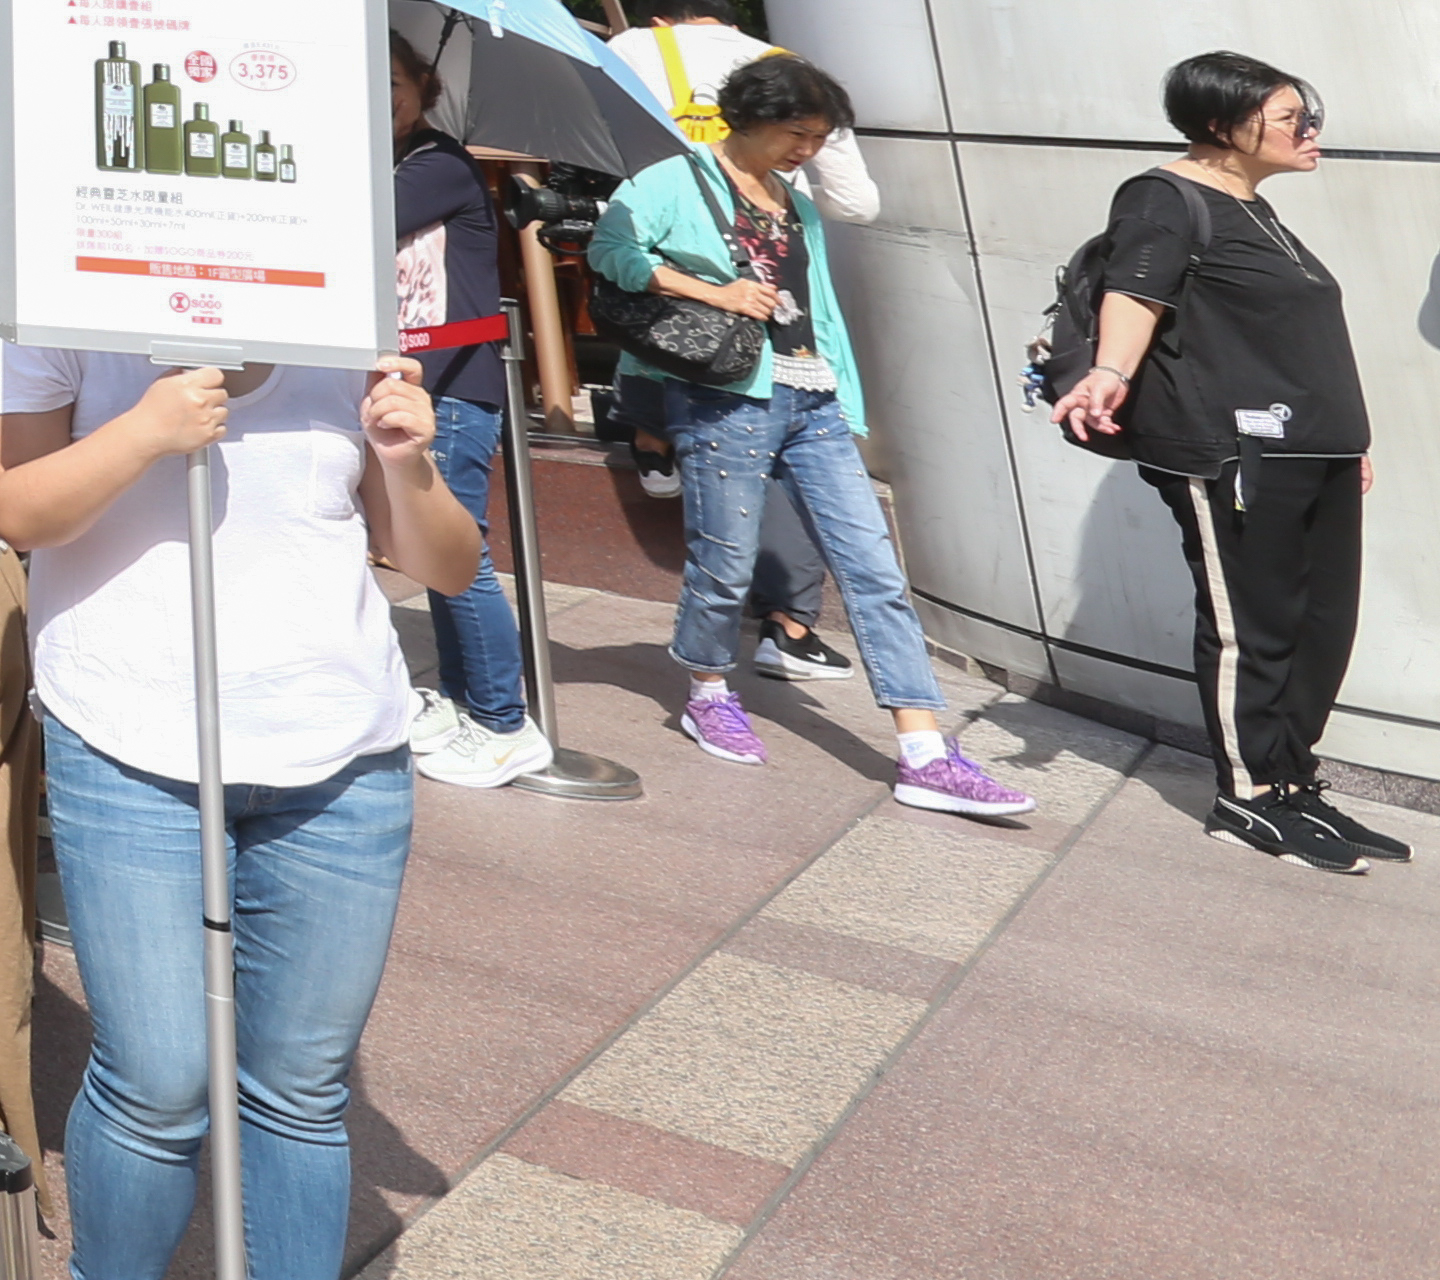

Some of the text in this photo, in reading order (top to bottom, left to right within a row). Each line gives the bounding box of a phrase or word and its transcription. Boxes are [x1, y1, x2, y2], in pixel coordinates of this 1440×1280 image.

[238, 62, 289, 80] 3,375
[191, 299, 222, 310] SOGO
[408, 332, 430, 348] SOGO
